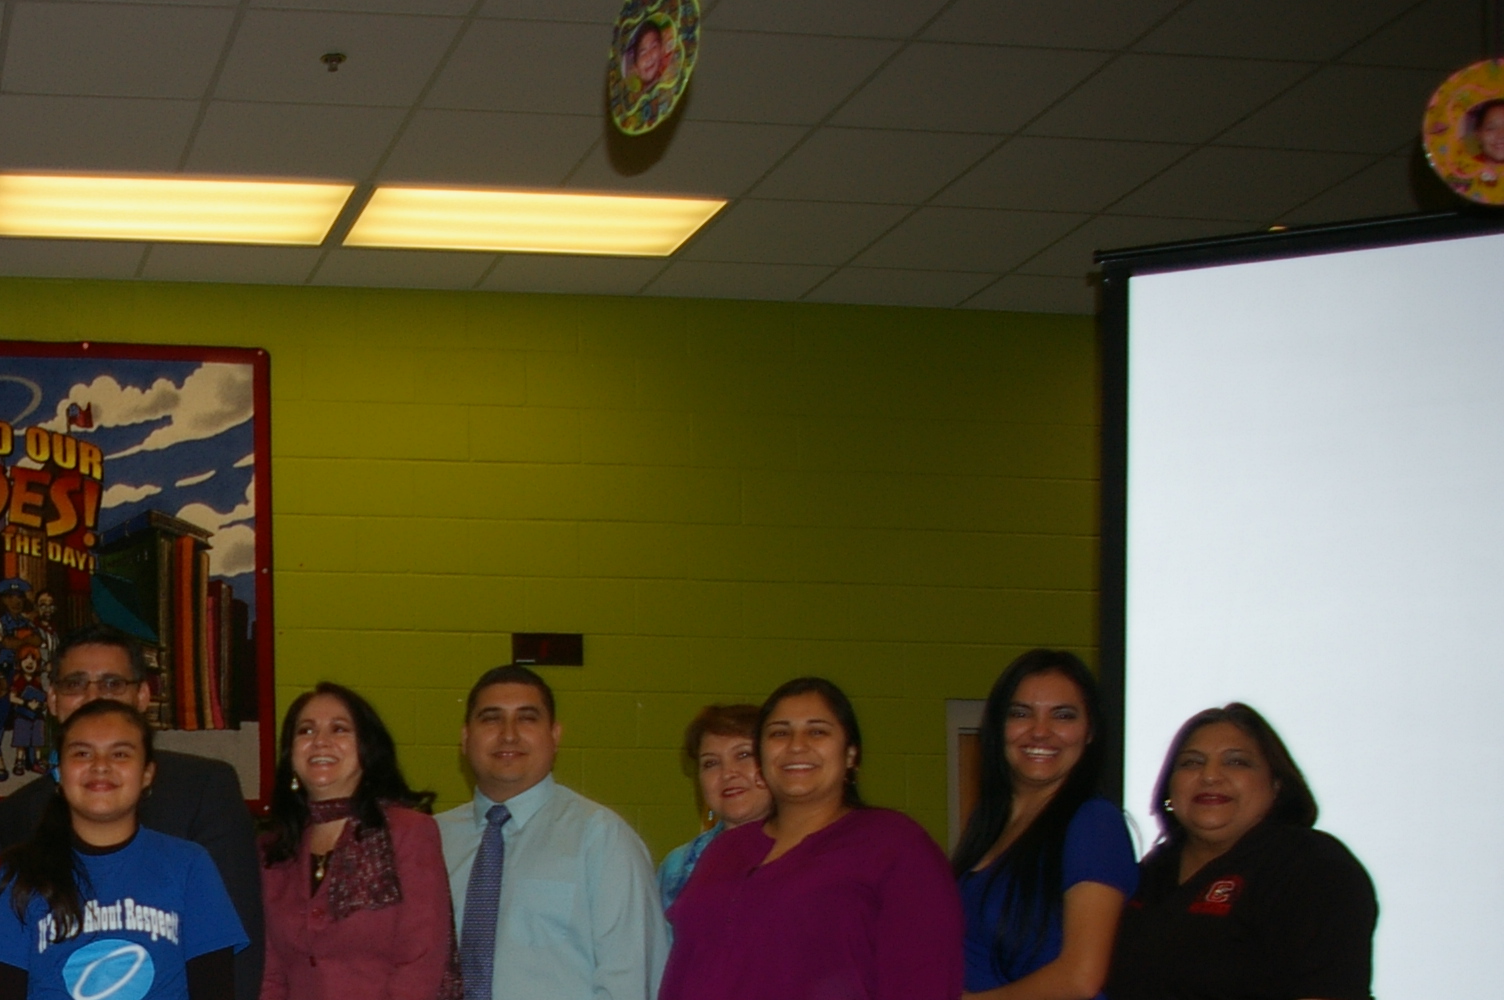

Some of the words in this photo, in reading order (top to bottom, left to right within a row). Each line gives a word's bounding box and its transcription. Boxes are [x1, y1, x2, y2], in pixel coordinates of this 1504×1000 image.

[25, 426, 104, 481] OUR
[3, 530, 43, 558] THE
[48, 540, 96, 575] DAY!
[83, 899, 122, 933] About
